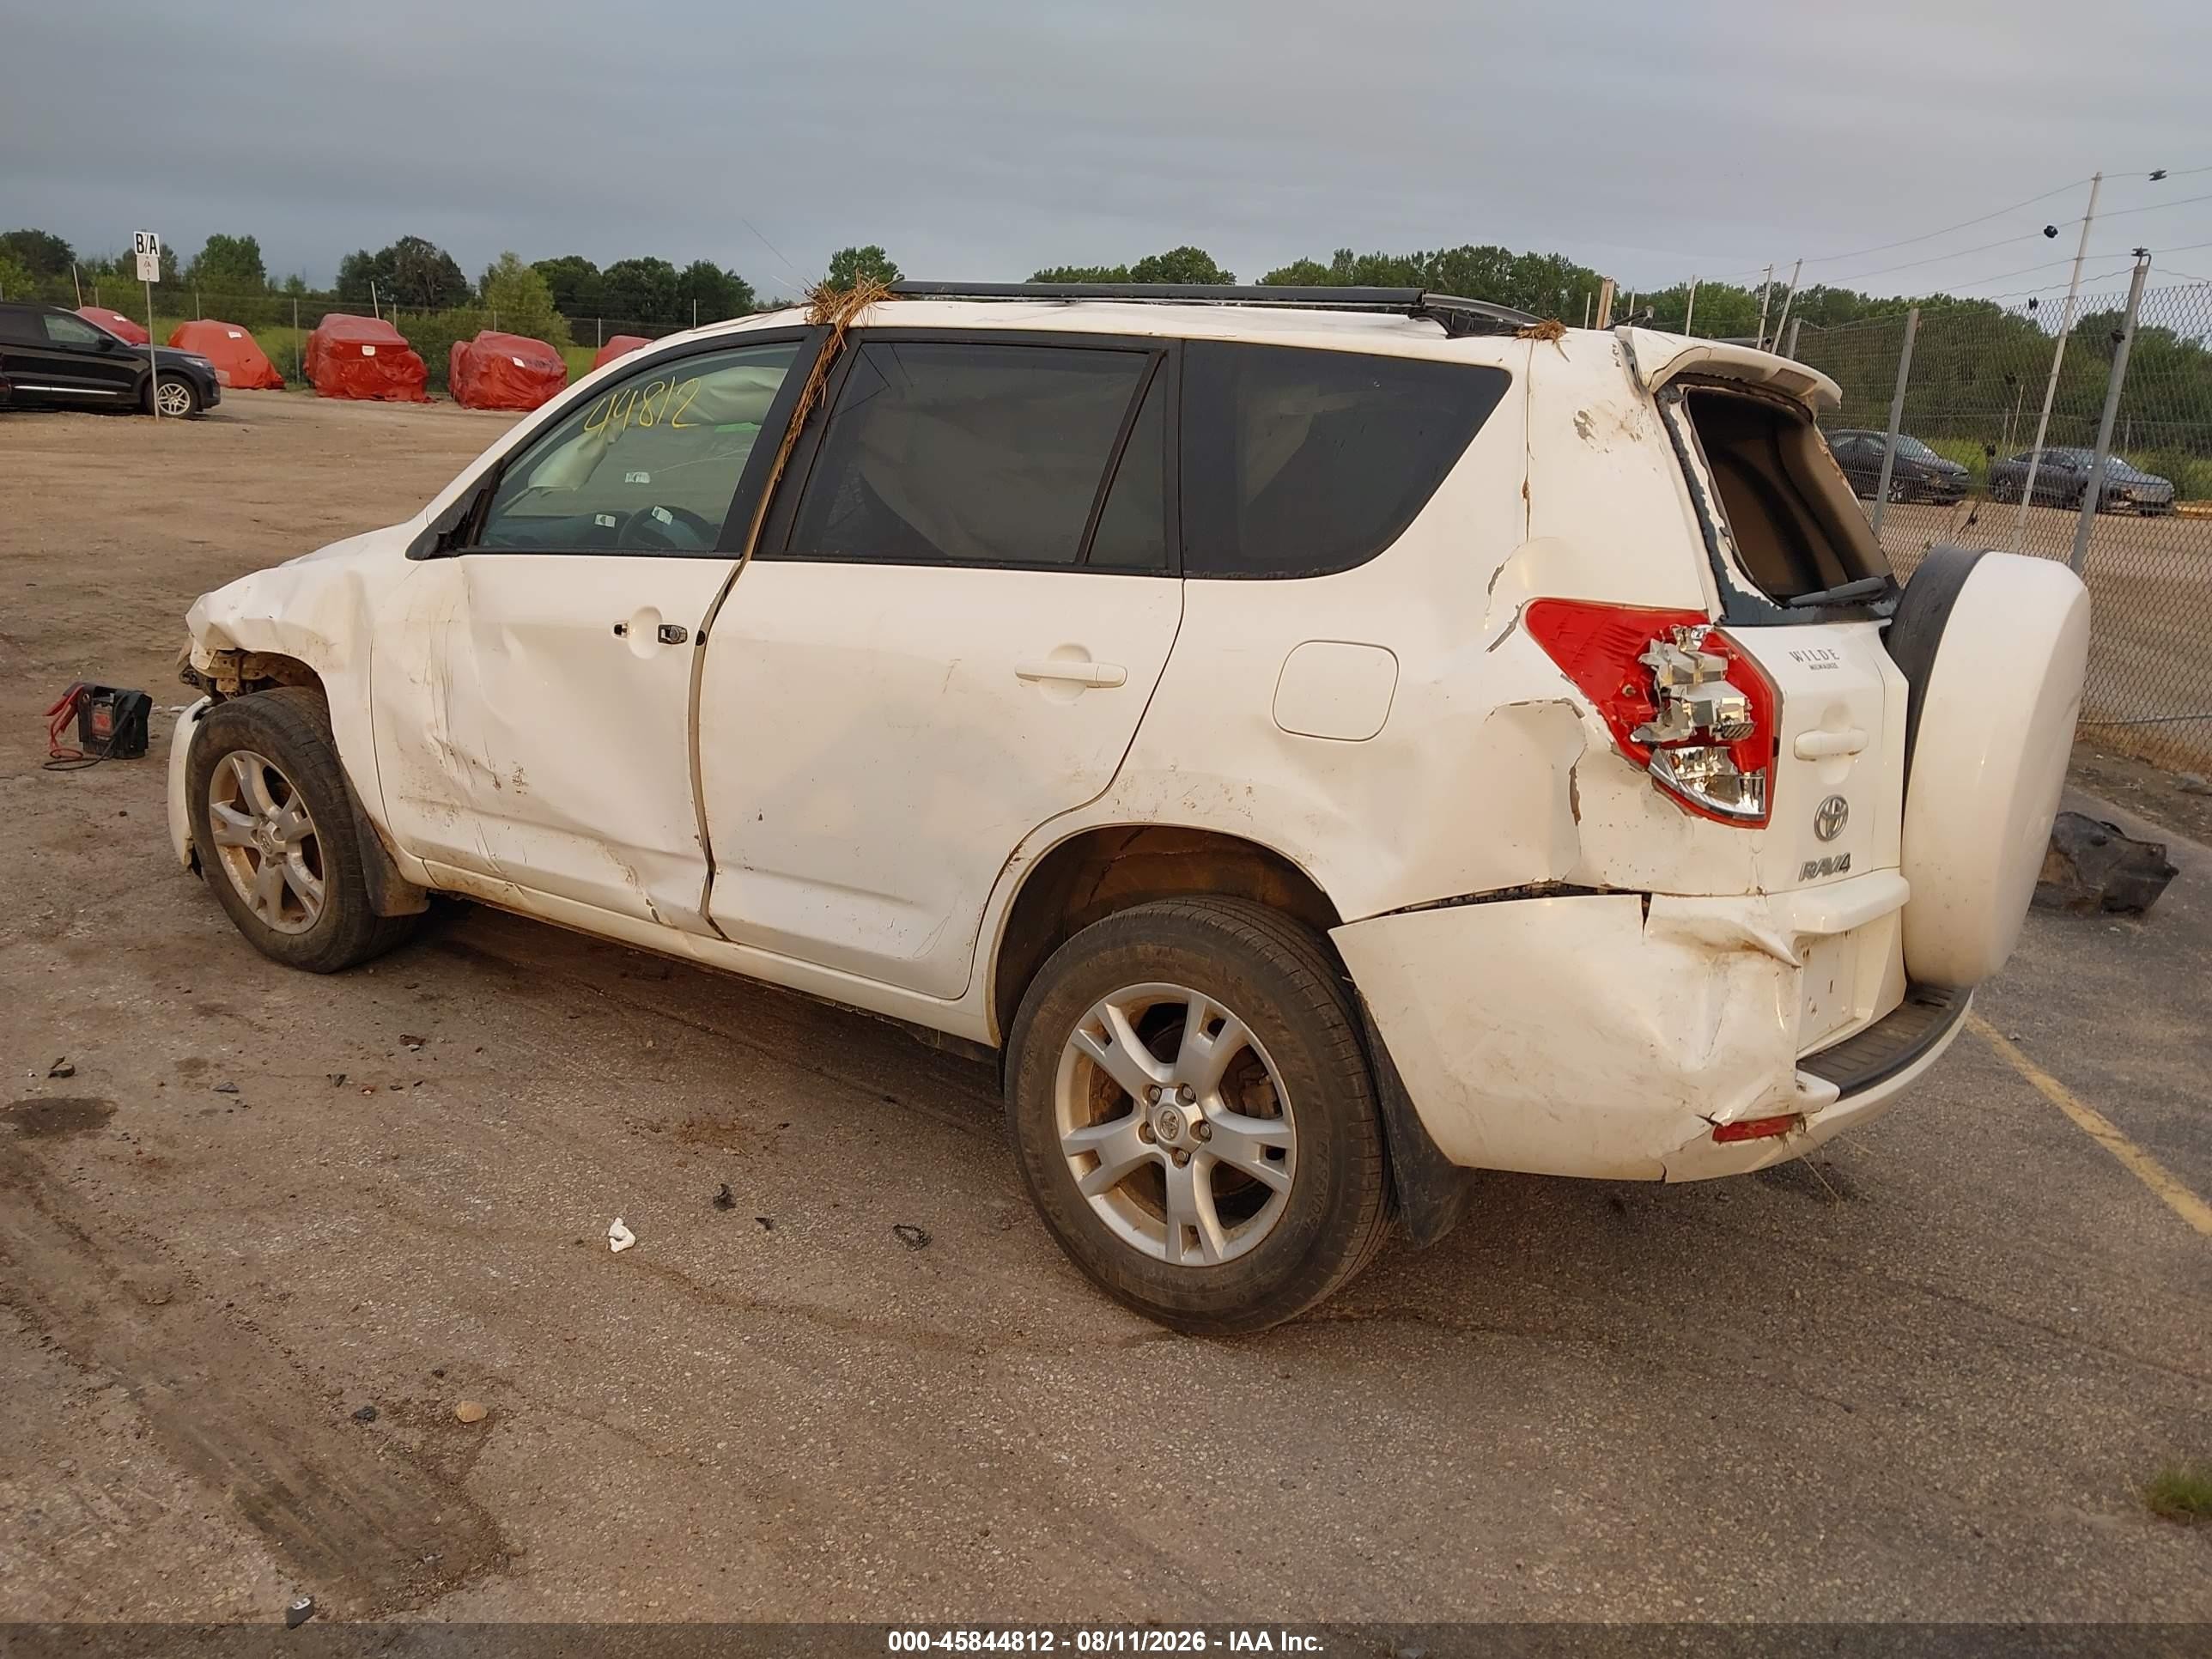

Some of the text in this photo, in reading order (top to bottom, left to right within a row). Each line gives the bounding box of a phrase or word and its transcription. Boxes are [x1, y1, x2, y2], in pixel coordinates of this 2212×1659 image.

[136, 233, 158, 255] B/A
[583, 375, 702, 439] 44812
[1788, 648, 1841, 663] WILDE
[1798, 852, 1851, 881] RAV4
